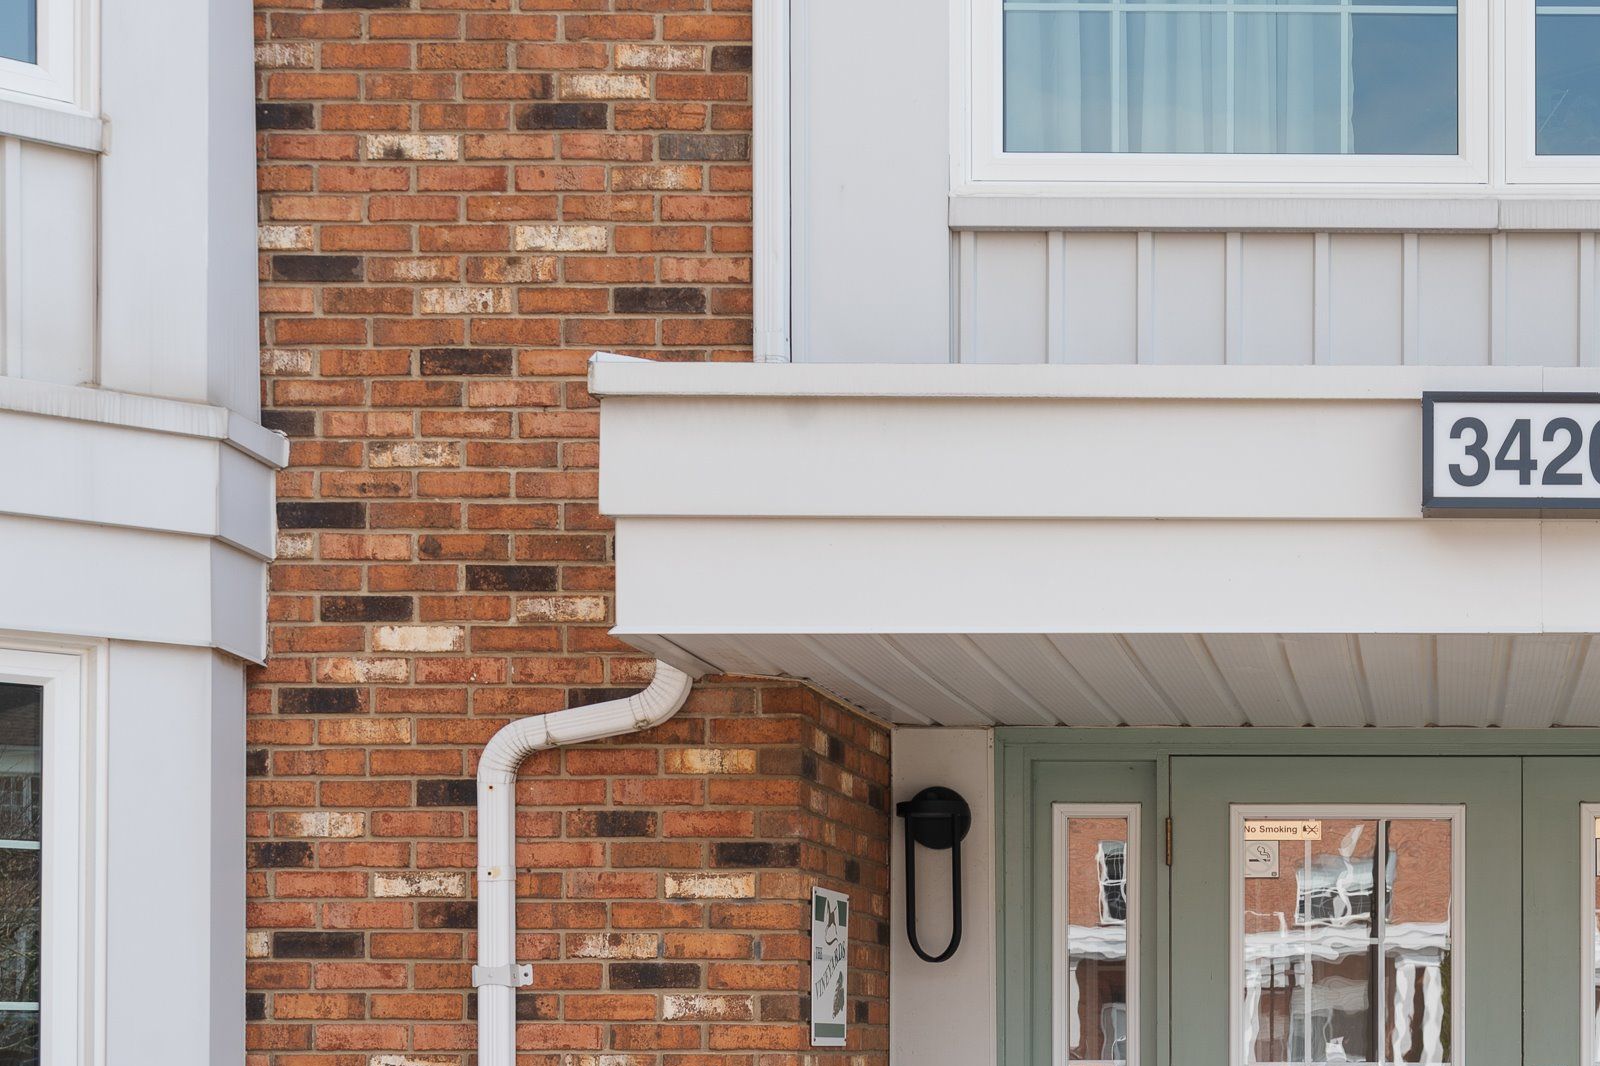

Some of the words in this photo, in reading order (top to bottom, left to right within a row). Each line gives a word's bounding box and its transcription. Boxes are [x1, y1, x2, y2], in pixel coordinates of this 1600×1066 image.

[1244, 825, 1257, 833] No
[1259, 825, 1298, 835] Smoking
[815, 941, 846, 1000] VINEYARDS
